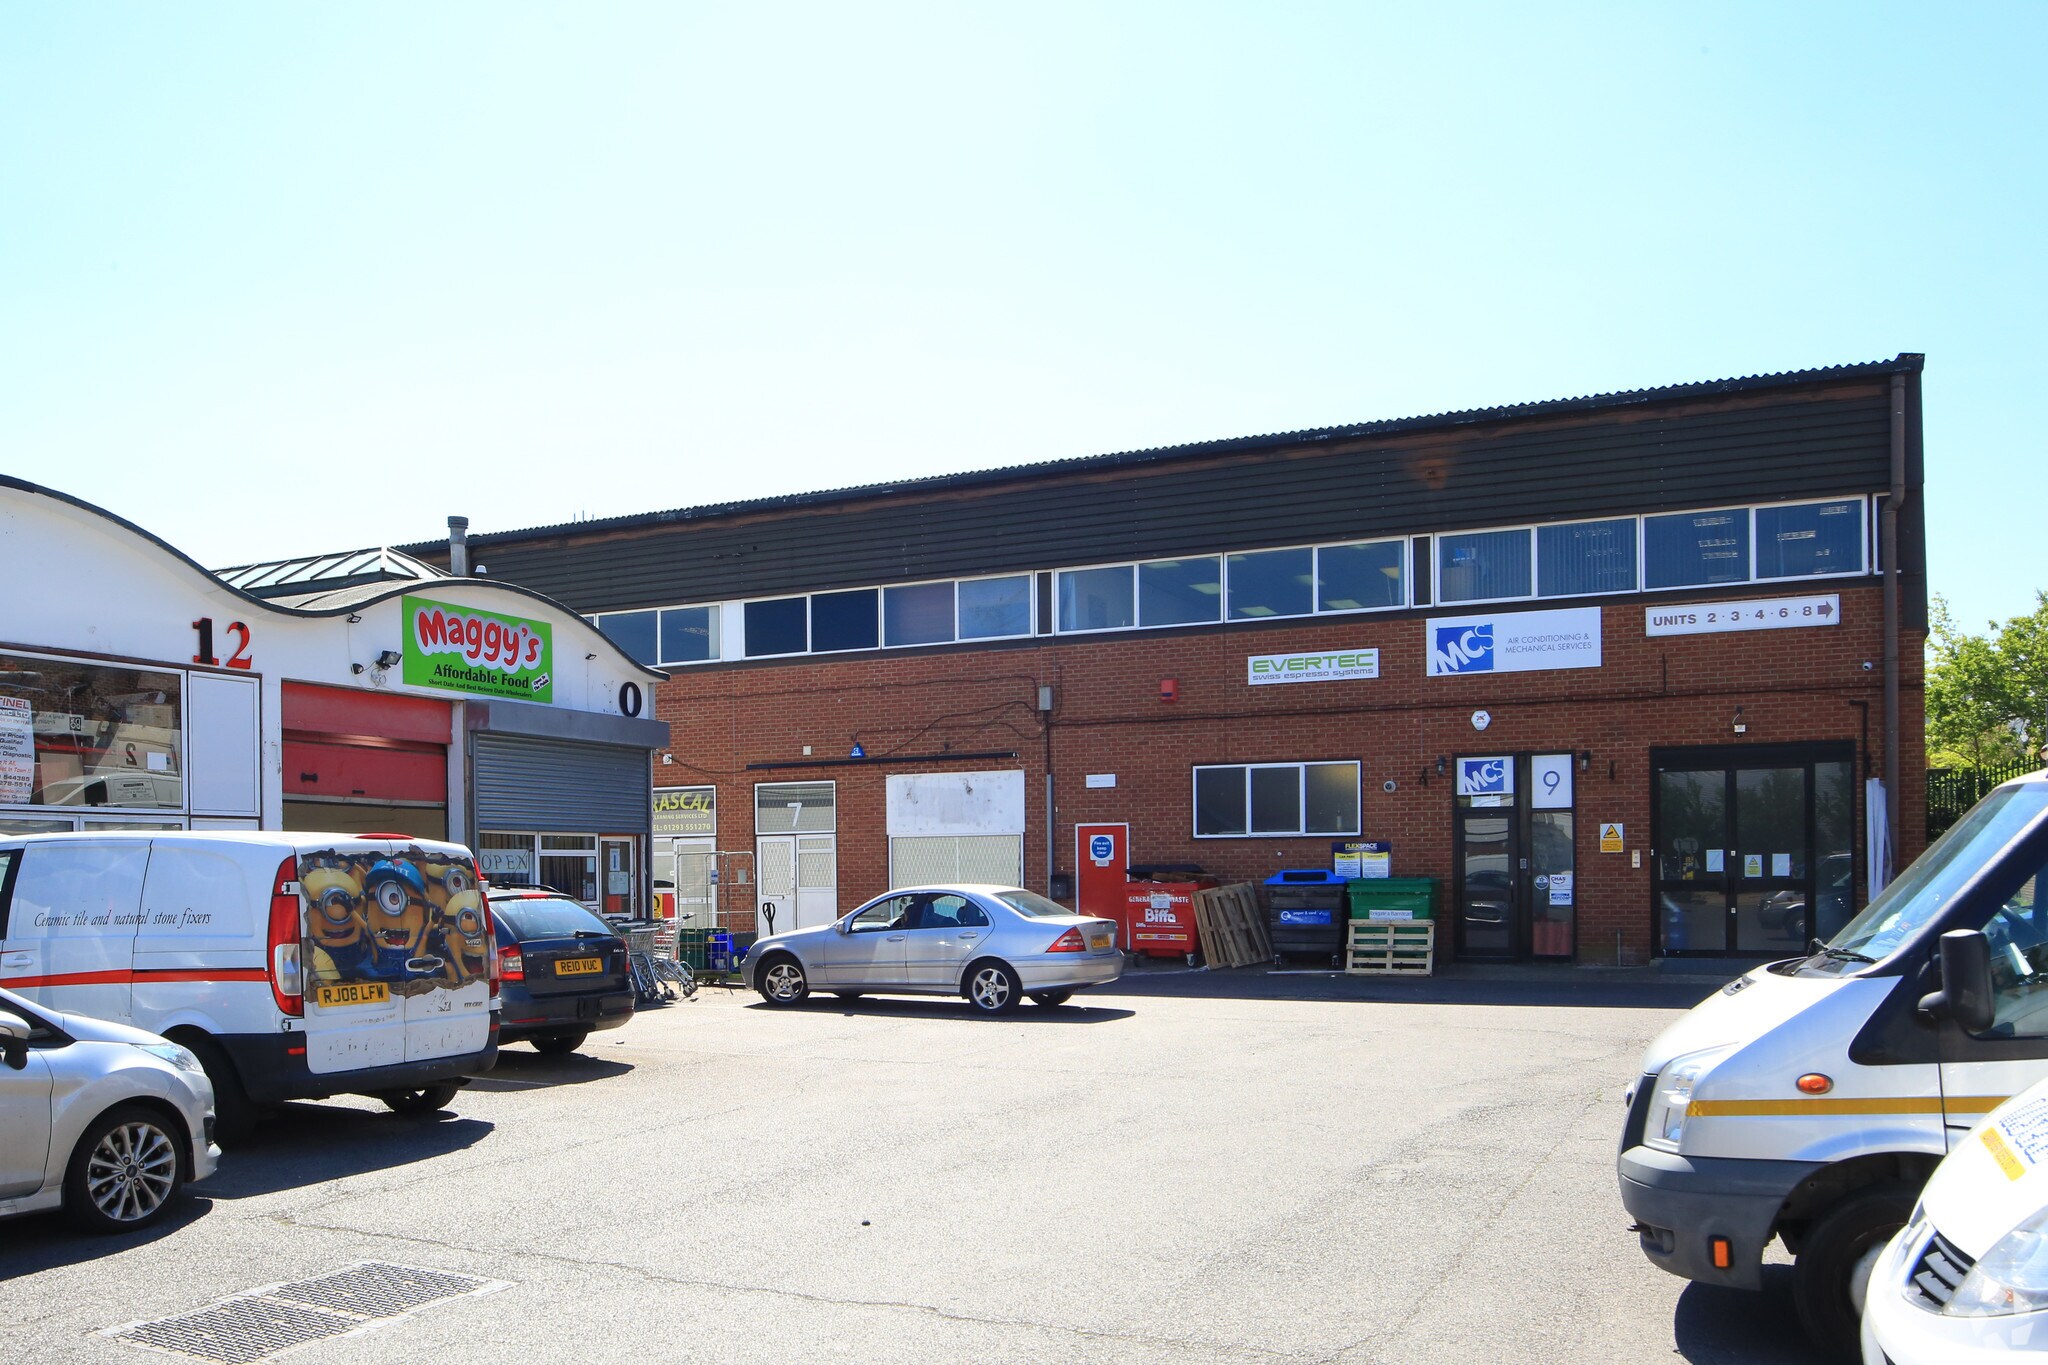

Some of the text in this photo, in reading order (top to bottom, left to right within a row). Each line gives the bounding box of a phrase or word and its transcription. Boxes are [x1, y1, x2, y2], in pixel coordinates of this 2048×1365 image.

[1653, 606, 1812, 626] UNITS 2 3 4 6 8
[192, 617, 252, 670] 12
[418, 610, 539, 666] Maggy's
[1505, 642, 1592, 654] MECHANICAL SERVICES
[1521, 634, 1579, 644] CONDITIONING
[1436, 624, 1494, 674] MCS
[1252, 653, 1374, 673] EVERTEC
[434, 664, 529, 688] Affordable Food
[1284, 671, 1330, 679] espresso
[1333, 668, 1374, 677] systems
[506, 688, 532, 698] Wholesalers
[1465, 761, 1504, 792] MCS
[1543, 770, 1560, 796] 9
[787, 802, 802, 828] 7
[482, 854, 528, 870] OPEN
[34, 908, 212, 929] Ceramic tile and natural stone fixers
[1145, 908, 1176, 922] Biffa
[560, 960, 597, 972] RE10 VUC
[323, 985, 384, 1003] RJ08 LFW
